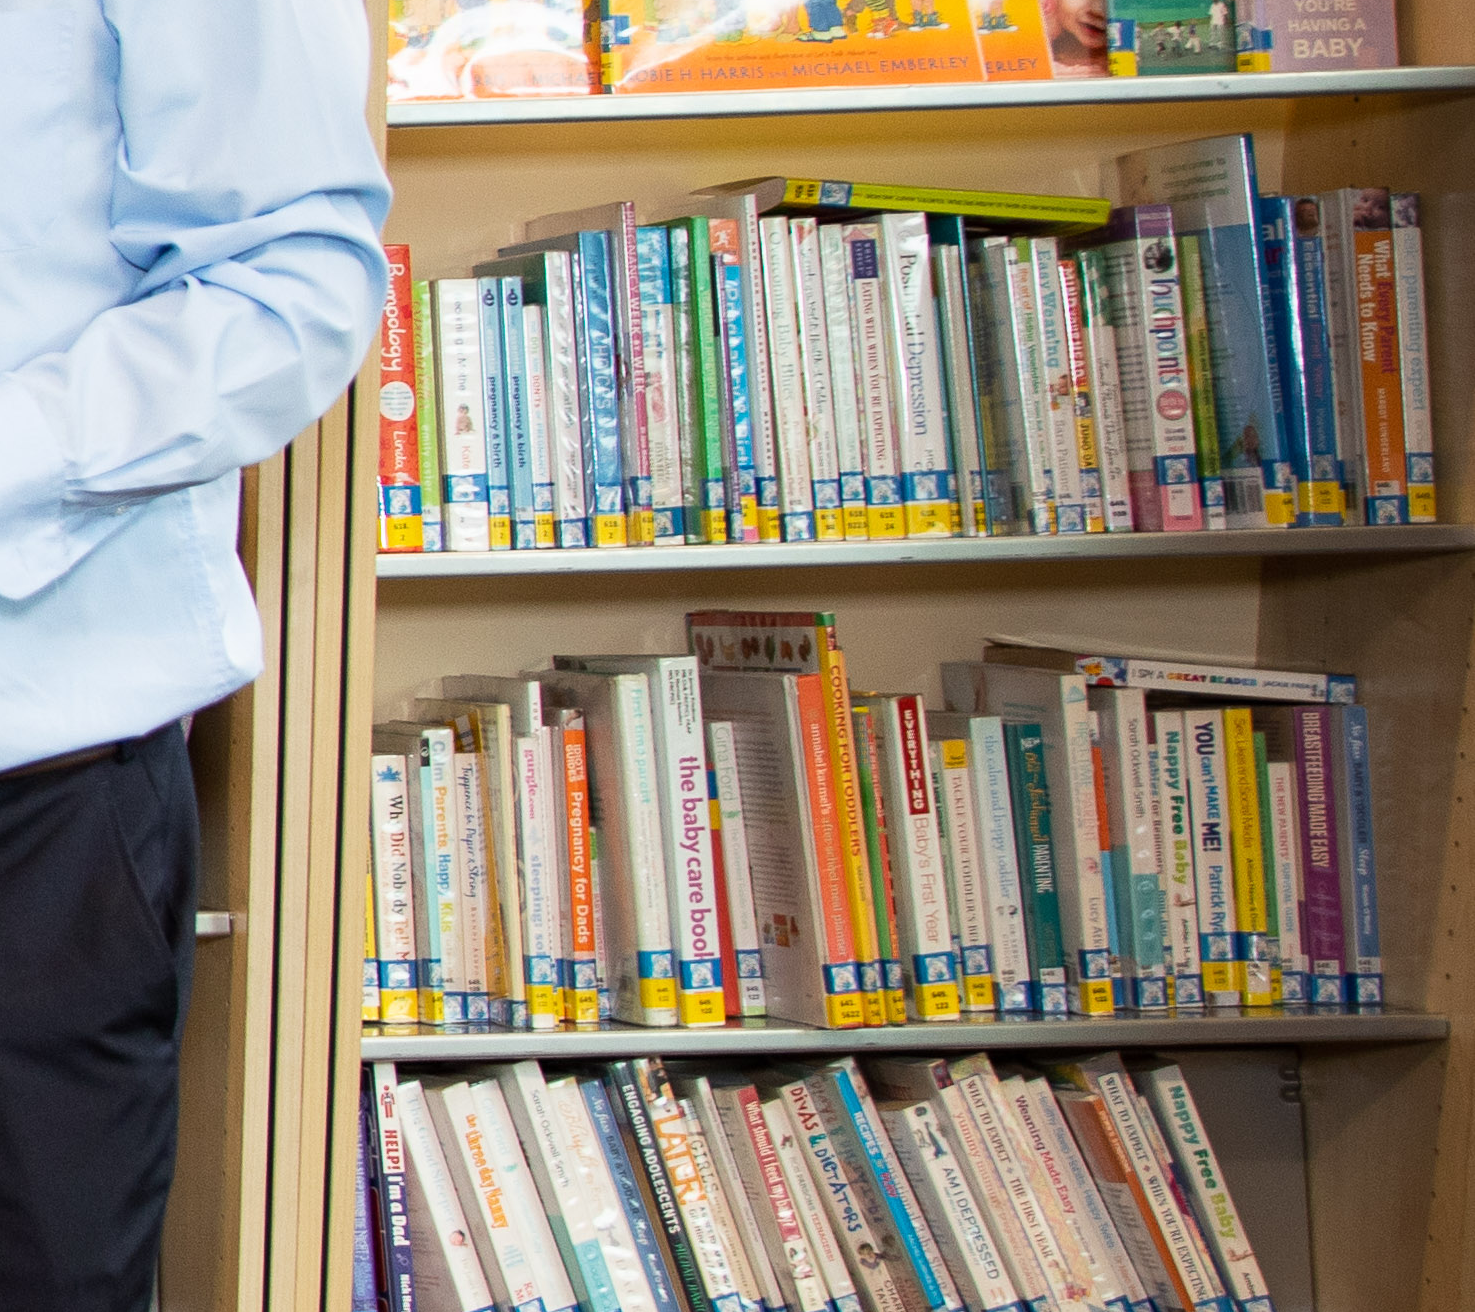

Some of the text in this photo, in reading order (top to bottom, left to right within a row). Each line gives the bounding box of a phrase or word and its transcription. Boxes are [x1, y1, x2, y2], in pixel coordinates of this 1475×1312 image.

[1288, 18, 1367, 33] HAVING A
[1292, 38, 1364, 59] BABY
[1357, 253, 1373, 293] Needs
[380, 263, 405, 373] Bumpology
[1361, 320, 1376, 363] Know
[909, 341, 927, 436] Depression
[394, 430, 409, 478] Linda
[566, 745, 574, 782] GUIDES
[679, 756, 695, 792] the
[831, 665, 862, 858] COOKING FOR TODDLERS
[904, 709, 923, 809] EVERYTHING
[1163, 730, 1191, 885] Nappy Free Baby
[1194, 722, 1221, 852] YOU can't MAKE ME!
[1302, 712, 1329, 868] BREASTFEEDING MADE EASY
[680, 800, 703, 851] baby
[570, 791, 590, 944] Pregnancy for Dads
[685, 853, 703, 903] care
[918, 816, 938, 944] Baby's First Year
[1032, 845, 1053, 893] PARENTING
[1210, 865, 1223, 910] Patrick
[385, 1129, 401, 1170] HELP!
[622, 1084, 681, 1234] ENGAGING ADOLESCENTS
[853, 1111, 879, 1158] RECIPES
[1015, 1095, 1074, 1213] Weaning Made Easy
[966, 1079, 1053, 1258] WHAT TO EXPECT THE FIRST YEAR
[1169, 1085, 1236, 1239] Nappy Free Baby
[387, 1175, 405, 1200] I'm
[392, 1216, 410, 1246] Dad
